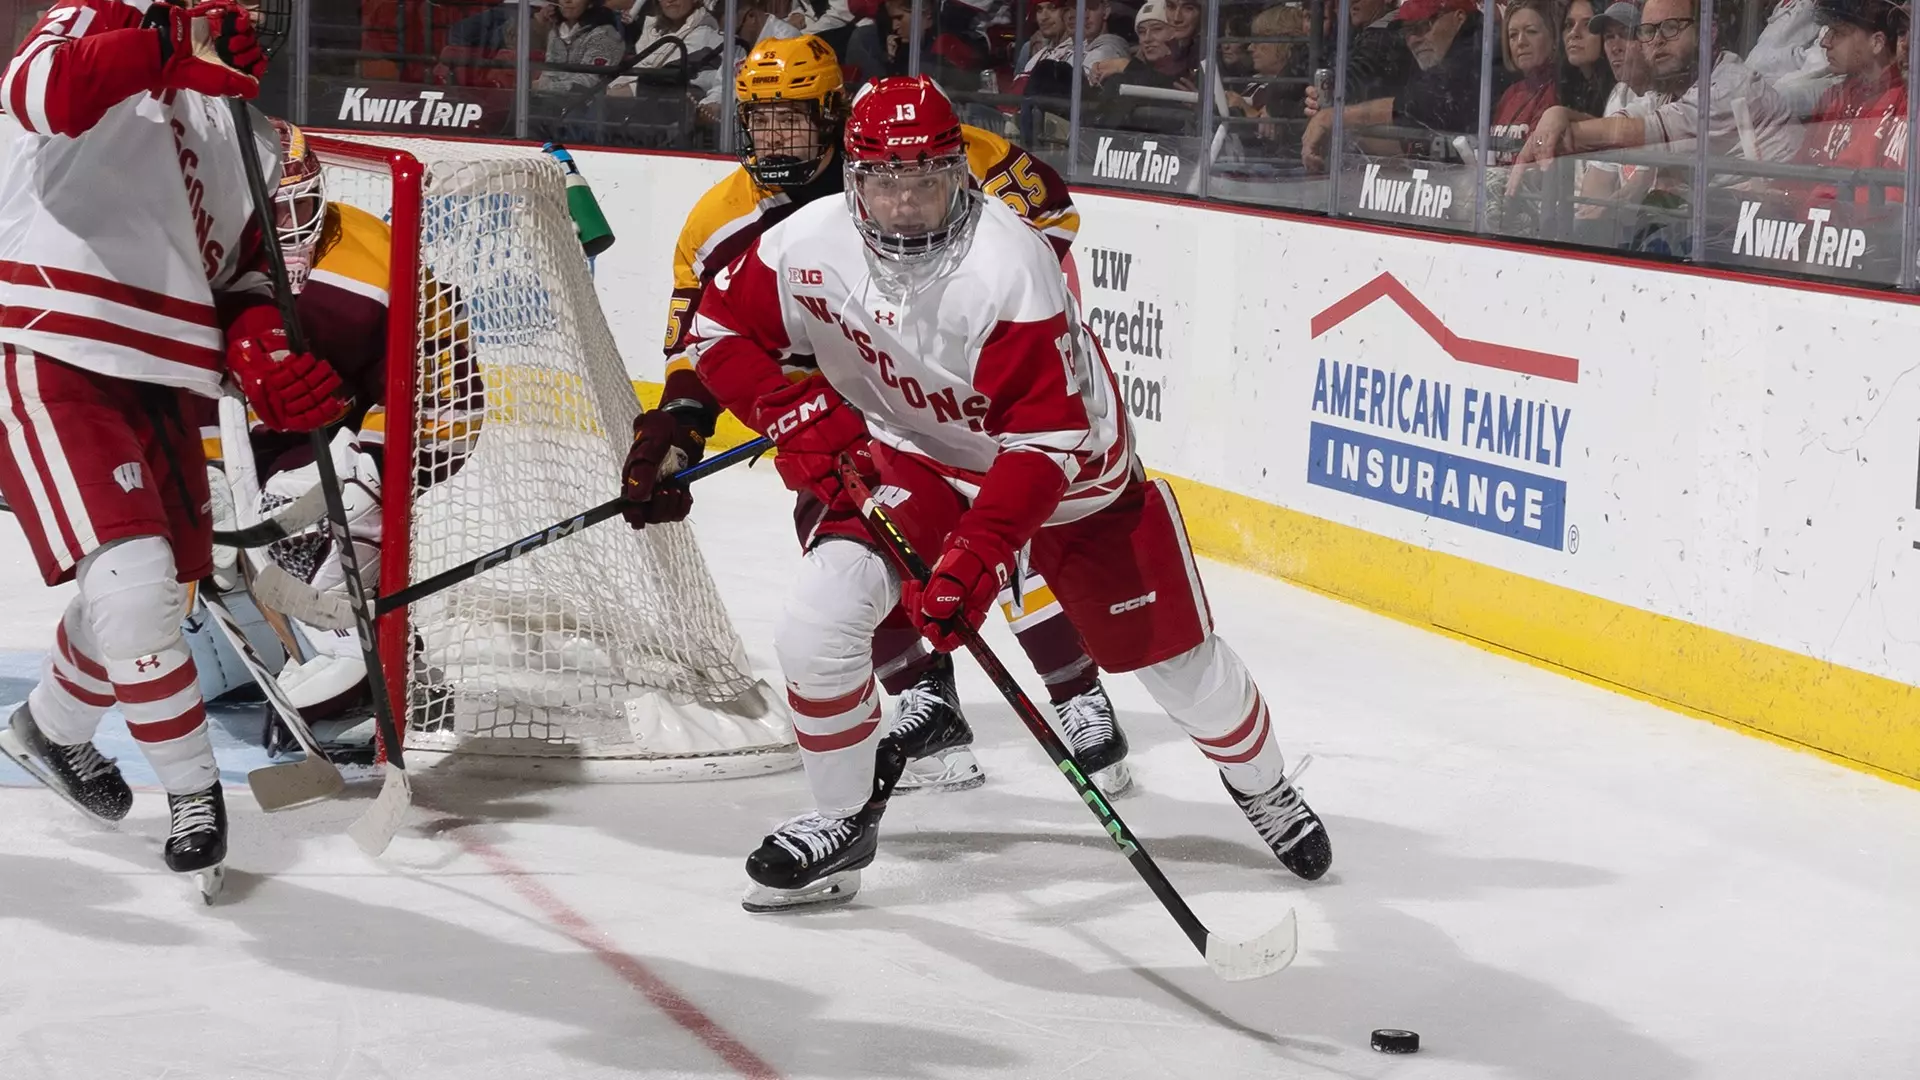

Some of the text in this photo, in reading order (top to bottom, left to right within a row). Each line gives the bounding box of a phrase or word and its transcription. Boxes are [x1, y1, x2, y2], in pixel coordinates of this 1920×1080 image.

[887, 135, 929, 146] CCM
[896, 103, 916, 121] 13
[982, 153, 1048, 217] 55
[1092, 248, 1132, 292] uw
[1089, 300, 1163, 360] credit
[766, 393, 828, 441] CCM
[1113, 360, 1161, 422] ion
[1311, 358, 1571, 468] AMERICAN FAMILY
[1326, 439, 1543, 530] INSURANCE
[473, 515, 586, 576] CCM
[1109, 590, 1156, 615] CCM
